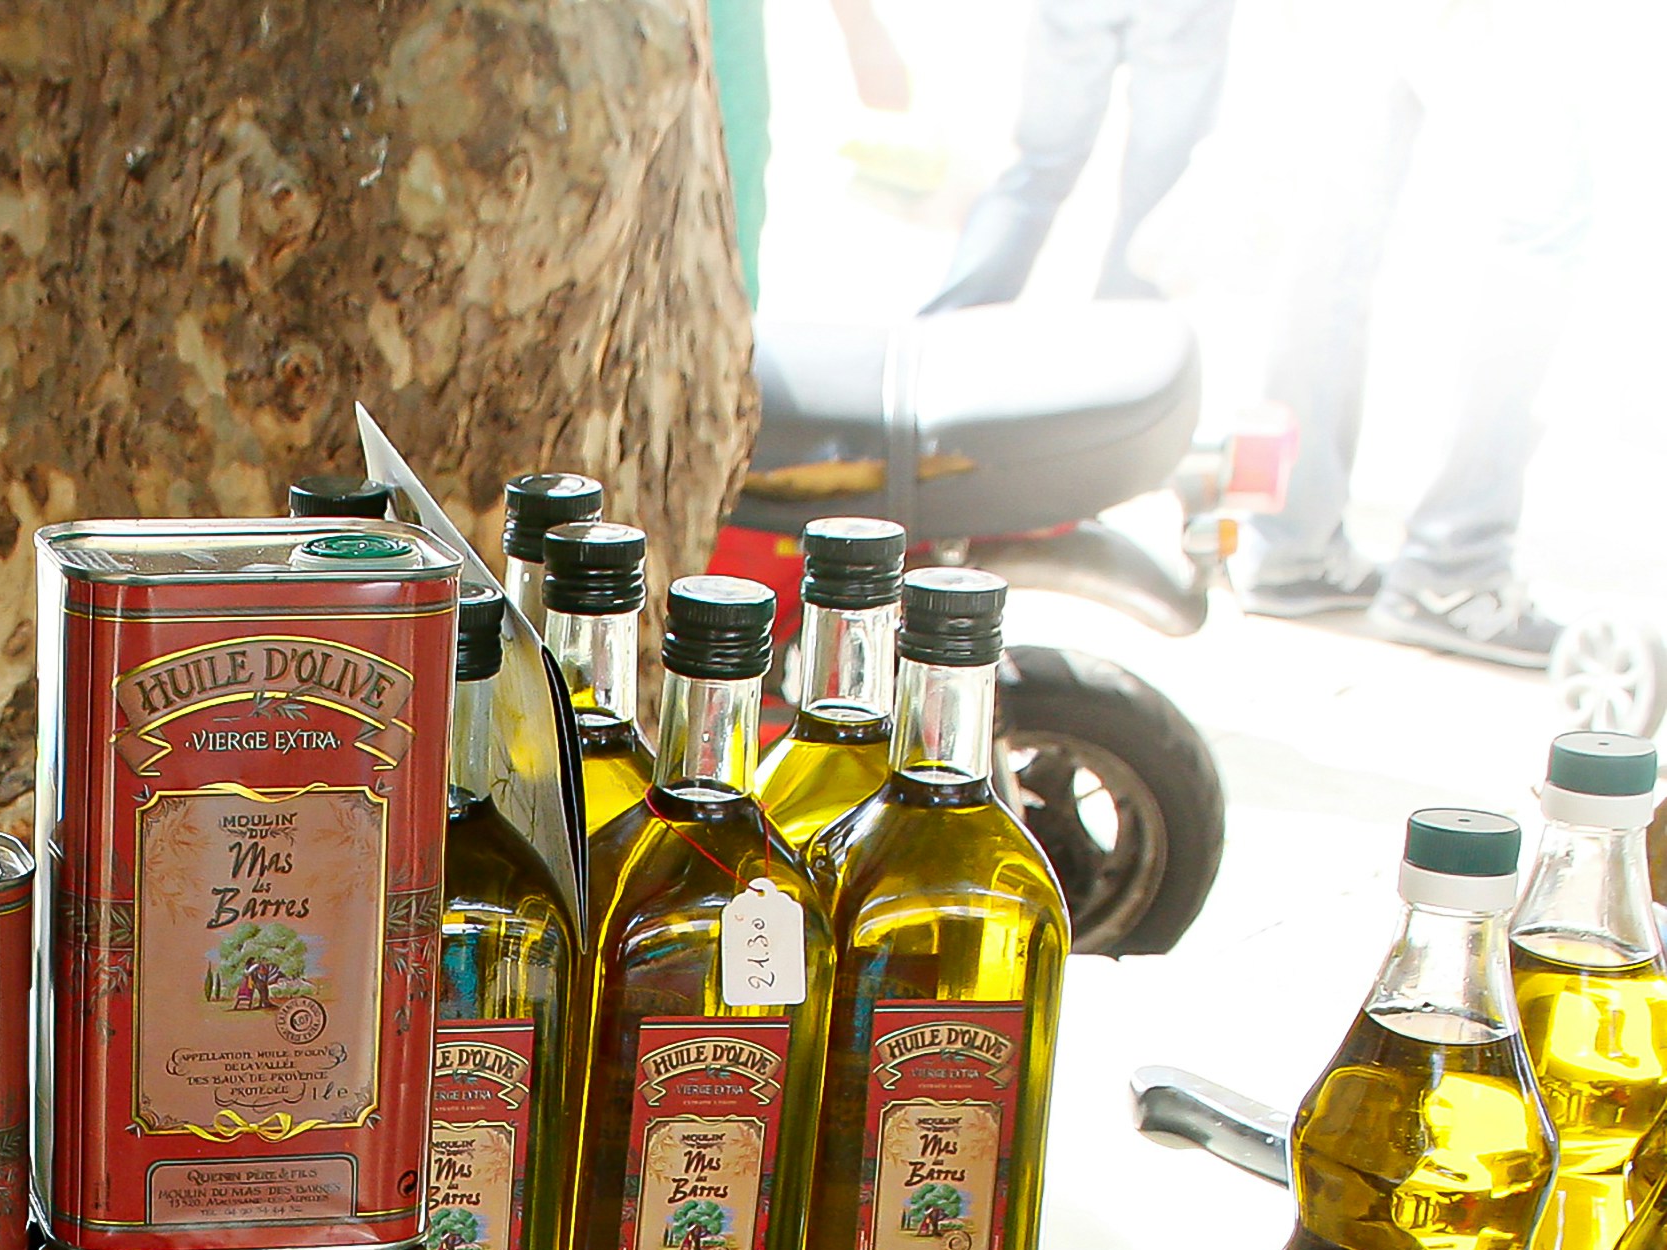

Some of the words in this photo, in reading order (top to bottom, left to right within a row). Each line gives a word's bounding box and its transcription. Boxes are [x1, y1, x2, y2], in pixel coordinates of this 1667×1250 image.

[135, 651, 253, 714] HUILE
[263, 648, 396, 709] D'OLIVE
[190, 730, 268, 752] VIERGE
[275, 730, 336, 754] EXTRA
[221, 813, 298, 827] MOULIN
[248, 828, 271, 839] DU
[229, 842, 293, 880] Mas
[207, 888, 309, 930] Barres
[886, 1028, 943, 1059] HUILE
[946, 1027, 1008, 1060] D'OLIVE
[458, 1049, 519, 1079] D'OLIVE
[652, 1045, 708, 1077] HUILE
[711, 1044, 773, 1076] D'OLIVE
[433, 1090, 459, 1100] ERGE
[920, 1133, 957, 1158] Mas
[434, 1157, 473, 1181] Mas
[683, 1150, 721, 1174] Mas
[904, 1161, 966, 1187] Barres
[667, 1177, 729, 1204] Barres
